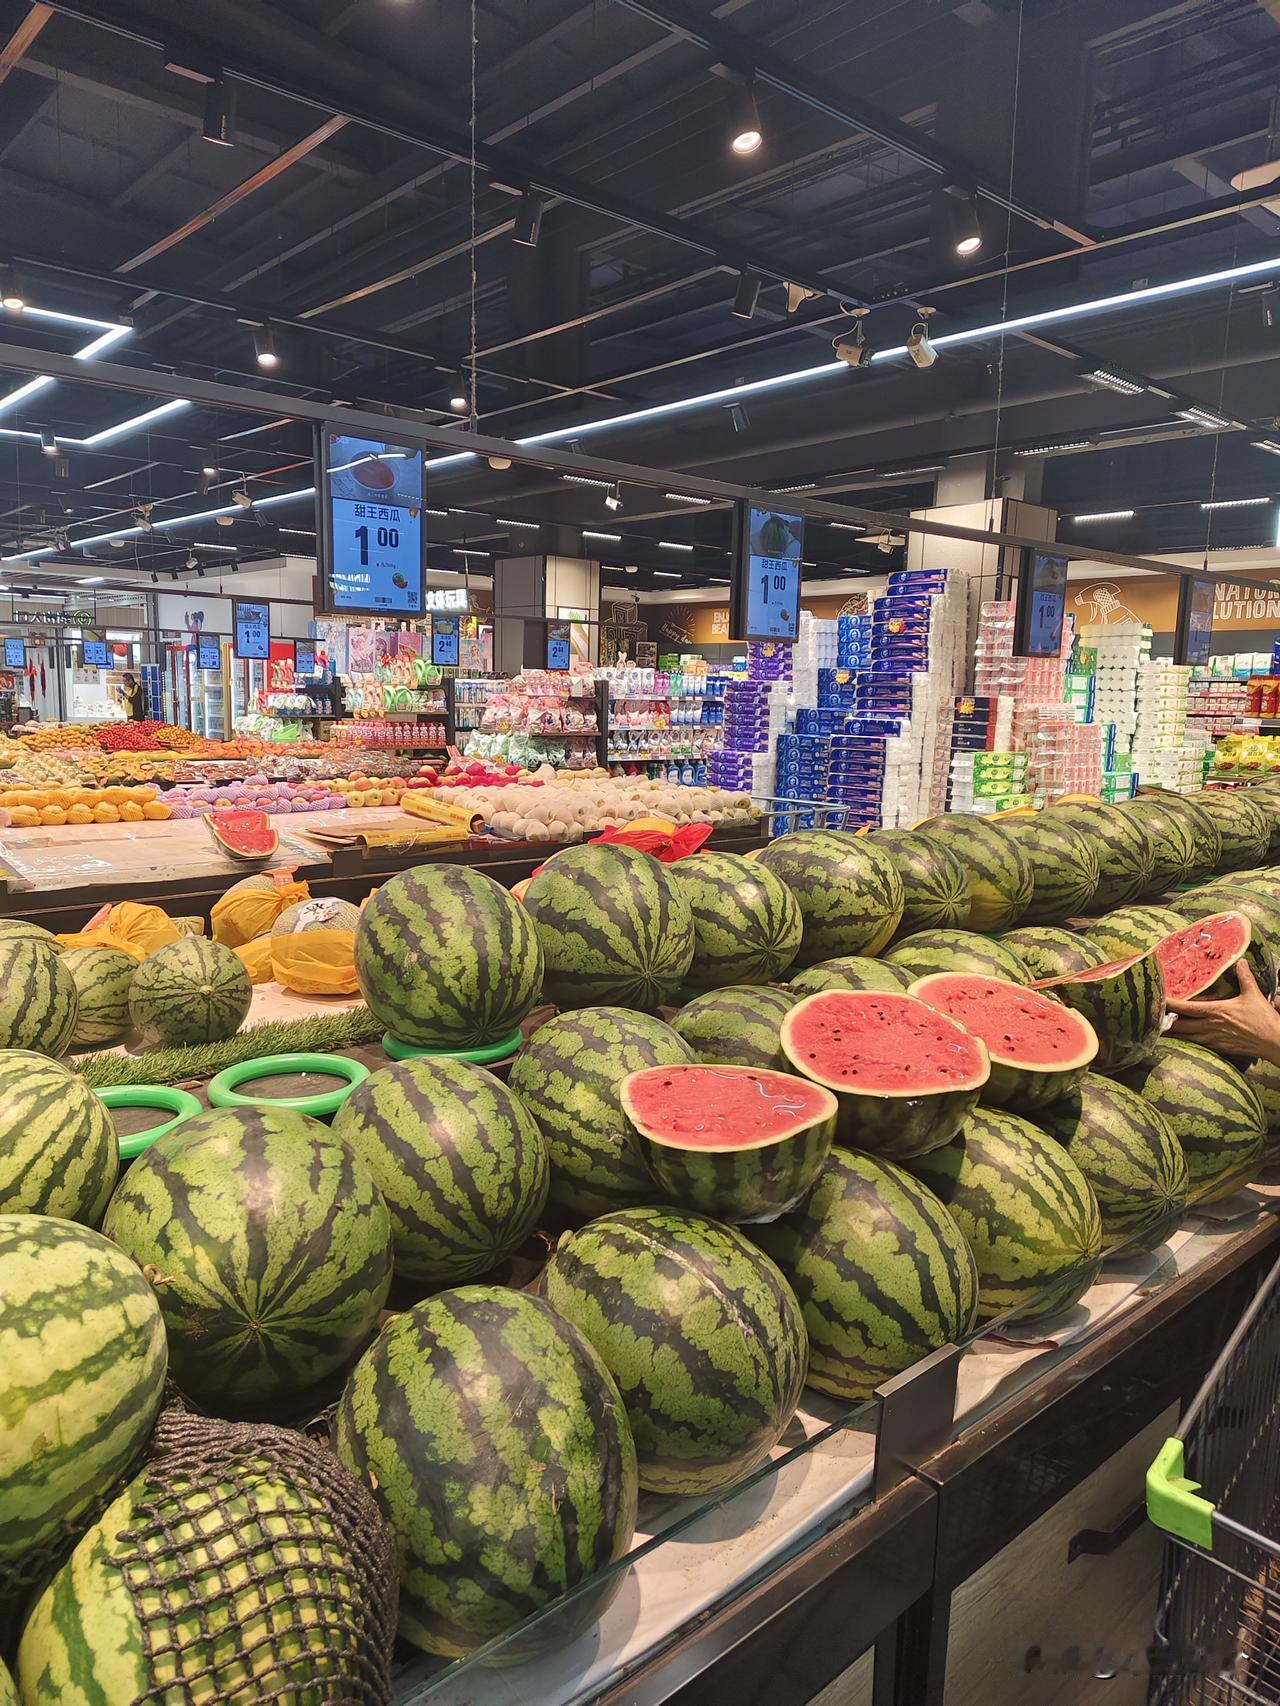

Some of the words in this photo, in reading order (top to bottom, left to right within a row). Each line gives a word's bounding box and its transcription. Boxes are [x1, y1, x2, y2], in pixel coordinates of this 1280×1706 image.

[354, 504, 400, 522] 甜王西瓜
[355, 526, 368, 566] 1
[377, 527, 399, 548] 00
[761, 575, 769, 605] 1
[774, 575, 786, 591] 00
[1039, 606, 1045, 629] 1
[1046, 606, 1056, 618] 00
[244, 630, 250, 644] 1
[438, 640, 445, 652] 2
[552, 646, 558, 657] 2
